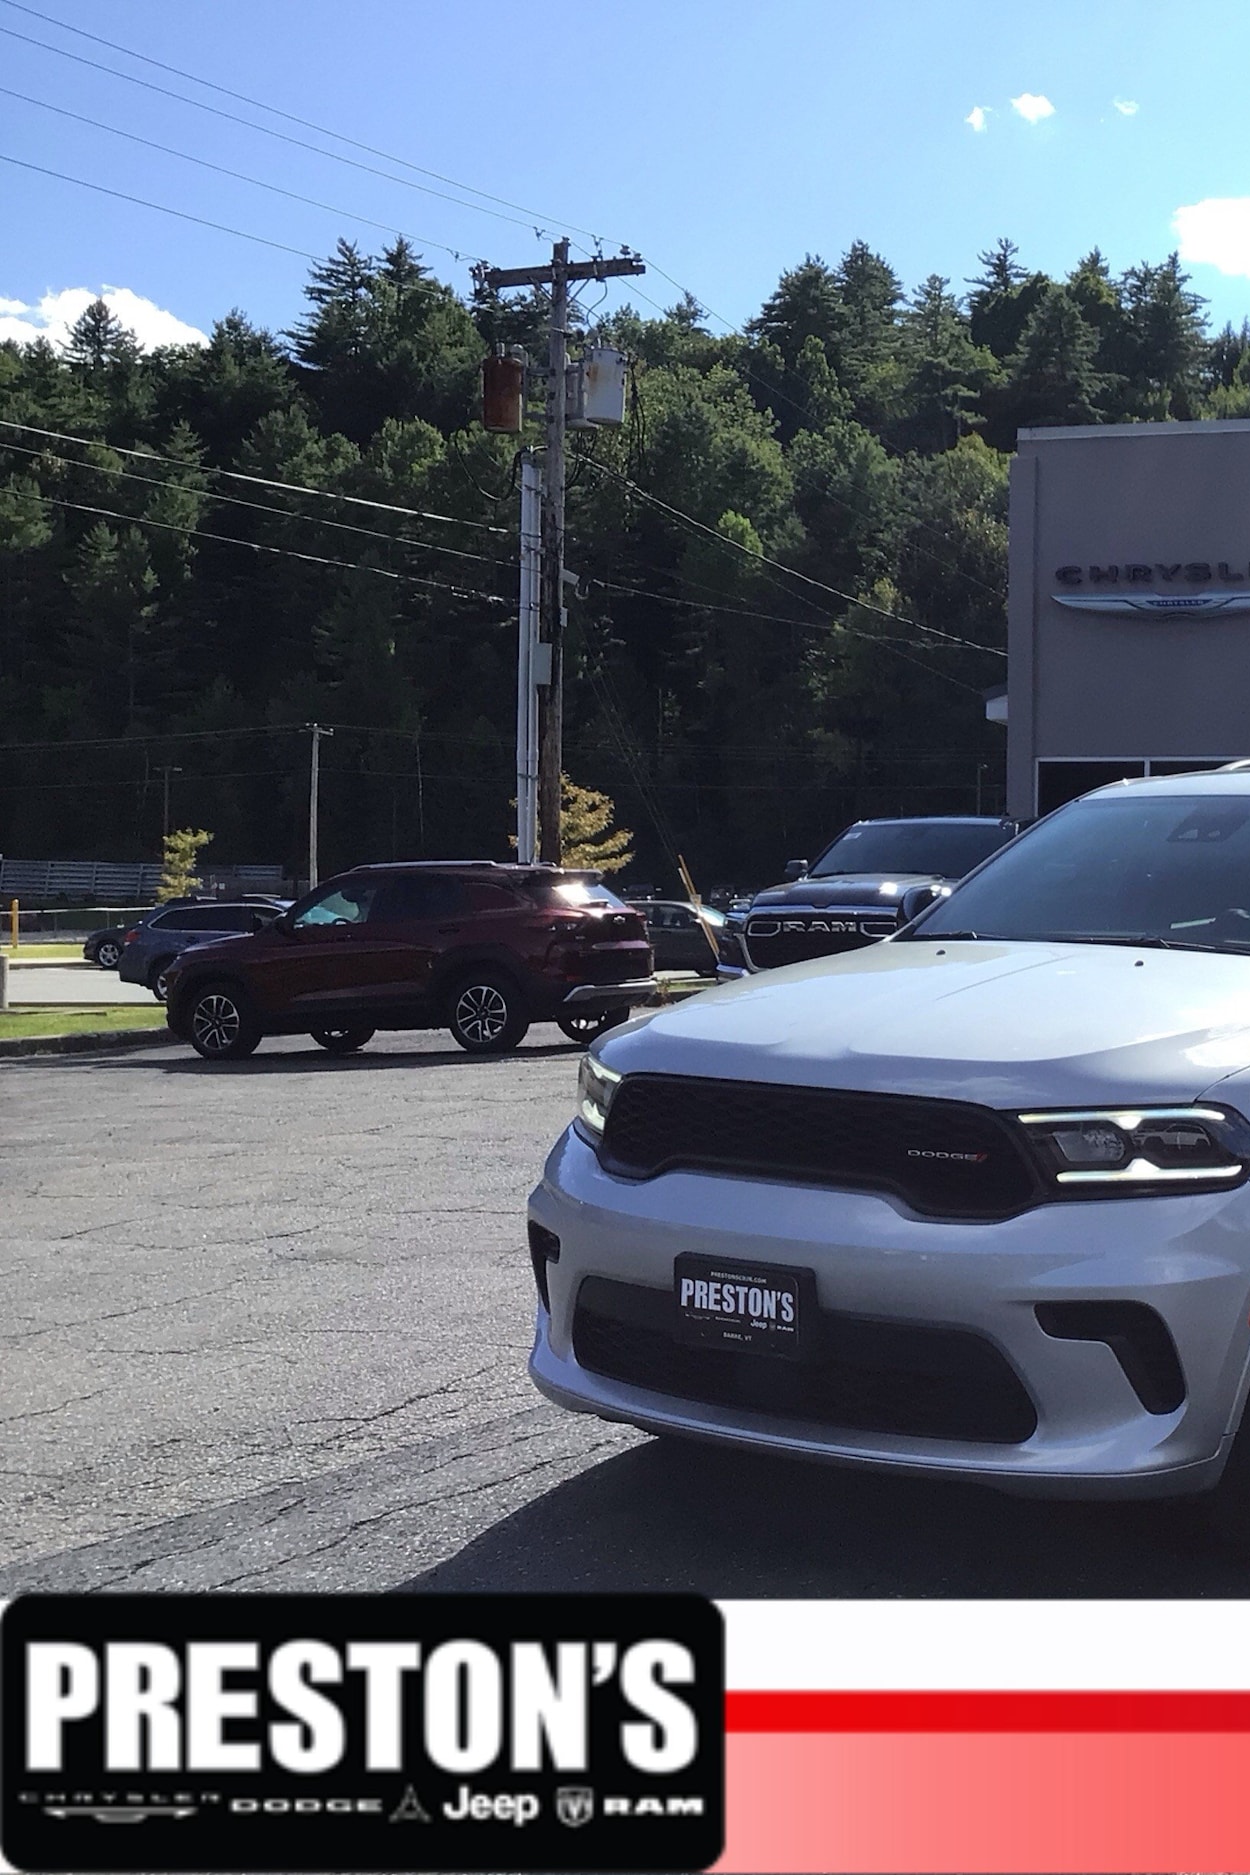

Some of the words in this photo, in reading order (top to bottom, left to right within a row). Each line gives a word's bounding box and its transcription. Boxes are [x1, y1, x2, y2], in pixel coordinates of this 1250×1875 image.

[783, 921, 857, 932] RAM
[907, 1149, 978, 1161] DODGE
[680, 1278, 795, 1322] PRESTON'S
[750, 1319, 768, 1330] Jeep
